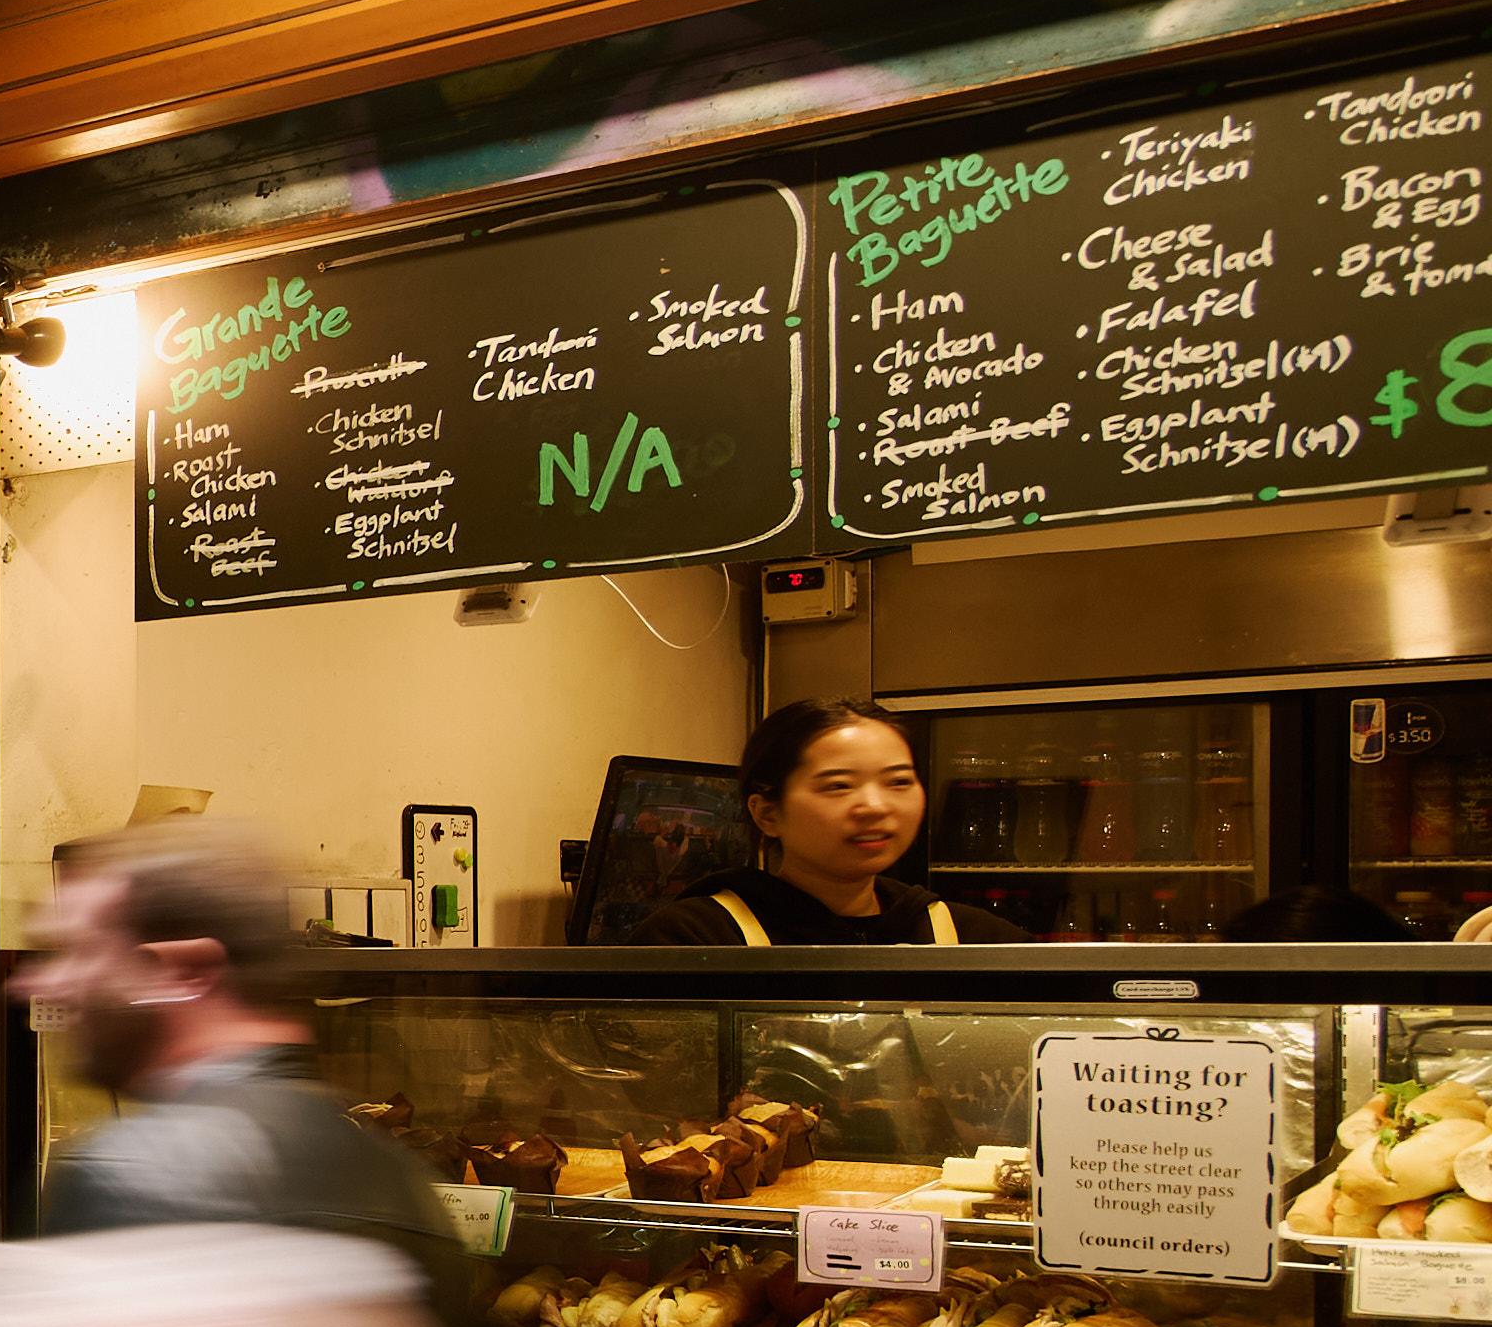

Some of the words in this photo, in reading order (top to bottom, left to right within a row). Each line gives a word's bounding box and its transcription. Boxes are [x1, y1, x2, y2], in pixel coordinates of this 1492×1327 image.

[1323, 72, 1474, 122] Tandoori
[1119, 116, 1256, 167] Teriyaki
[1340, 109, 1480, 145] Chicken
[828, 152, 993, 236] Petite
[1103, 158, 1249, 207] Chicken
[1340, 165, 1481, 213] Bacon
[847, 158, 1070, 289] Baguette
[1373, 204, 1403, 229] &
[1413, 191, 1480, 227] Egg
[1077, 221, 1213, 269] Cheese
[1128, 263, 1157, 291] &
[1167, 231, 1273, 284] Salad
[1339, 237, 1434, 277] Brie
[650, 286, 768, 321] Smoked
[1361, 271, 1395, 297] &
[152, 276, 314, 366] Grande
[871, 290, 964, 330] Ham
[1096, 280, 1258, 342] Falafel
[166, 300, 352, 416] Baguette
[476, 328, 599, 368] Tandoori
[648, 321, 765, 356] Salmon
[873, 329, 994, 374] Chicken
[1095, 336, 1237, 380] Chicken
[472, 366, 595, 404] Chicken
[888, 372, 911, 397] &
[923, 350, 1044, 389] Avocado
[1120, 338, 1279, 401] Schnitzel
[175, 420, 229, 449] Ham
[316, 401, 413, 433] Chicken
[332, 410, 441, 454] Schnitzel
[877, 393, 982, 438] Salami
[1100, 391, 1276, 443] Eggplant
[174, 446, 240, 482] Roast
[539, 412, 682, 513] N/A
[1120, 421, 1288, 475] Schnitzel
[190, 468, 276, 498] Chicken
[881, 463, 987, 508] Smoked
[922, 483, 1045, 522] Salmon
[180, 495, 257, 527] Salami
[334, 503, 443, 541] Eggplant
[348, 525, 458, 561] Schnitzel
[1072, 1061, 1192, 1091] Waiting
[1201, 1064, 1247, 1088] for
[1087, 1094, 1228, 1123] toasting?
[1070, 1156, 1106, 1176] keep
[1111, 1157, 1139, 1174] the
[1144, 1159, 1192, 1177] street
[1198, 1162, 1242, 1179] clear
[1096, 1138, 1148, 1156] Please
[1154, 1140, 1188, 1161] help
[1194, 1145, 1213, 1158] us
[1075, 1178, 1092, 1190] so
[1097, 1176, 1151, 1194] others
[1157, 1183, 1192, 1200] may
[1198, 1186, 1235, 1200] pass
[1093, 1194, 1162, 1217] through
[1167, 1200, 1216, 1219] easily
[829, 1218, 860, 1230] Cake
[869, 1219, 899, 1232] Slice
[1078, 1232, 1154, 1253] (council
[1161, 1237, 1231, 1256] orders)
